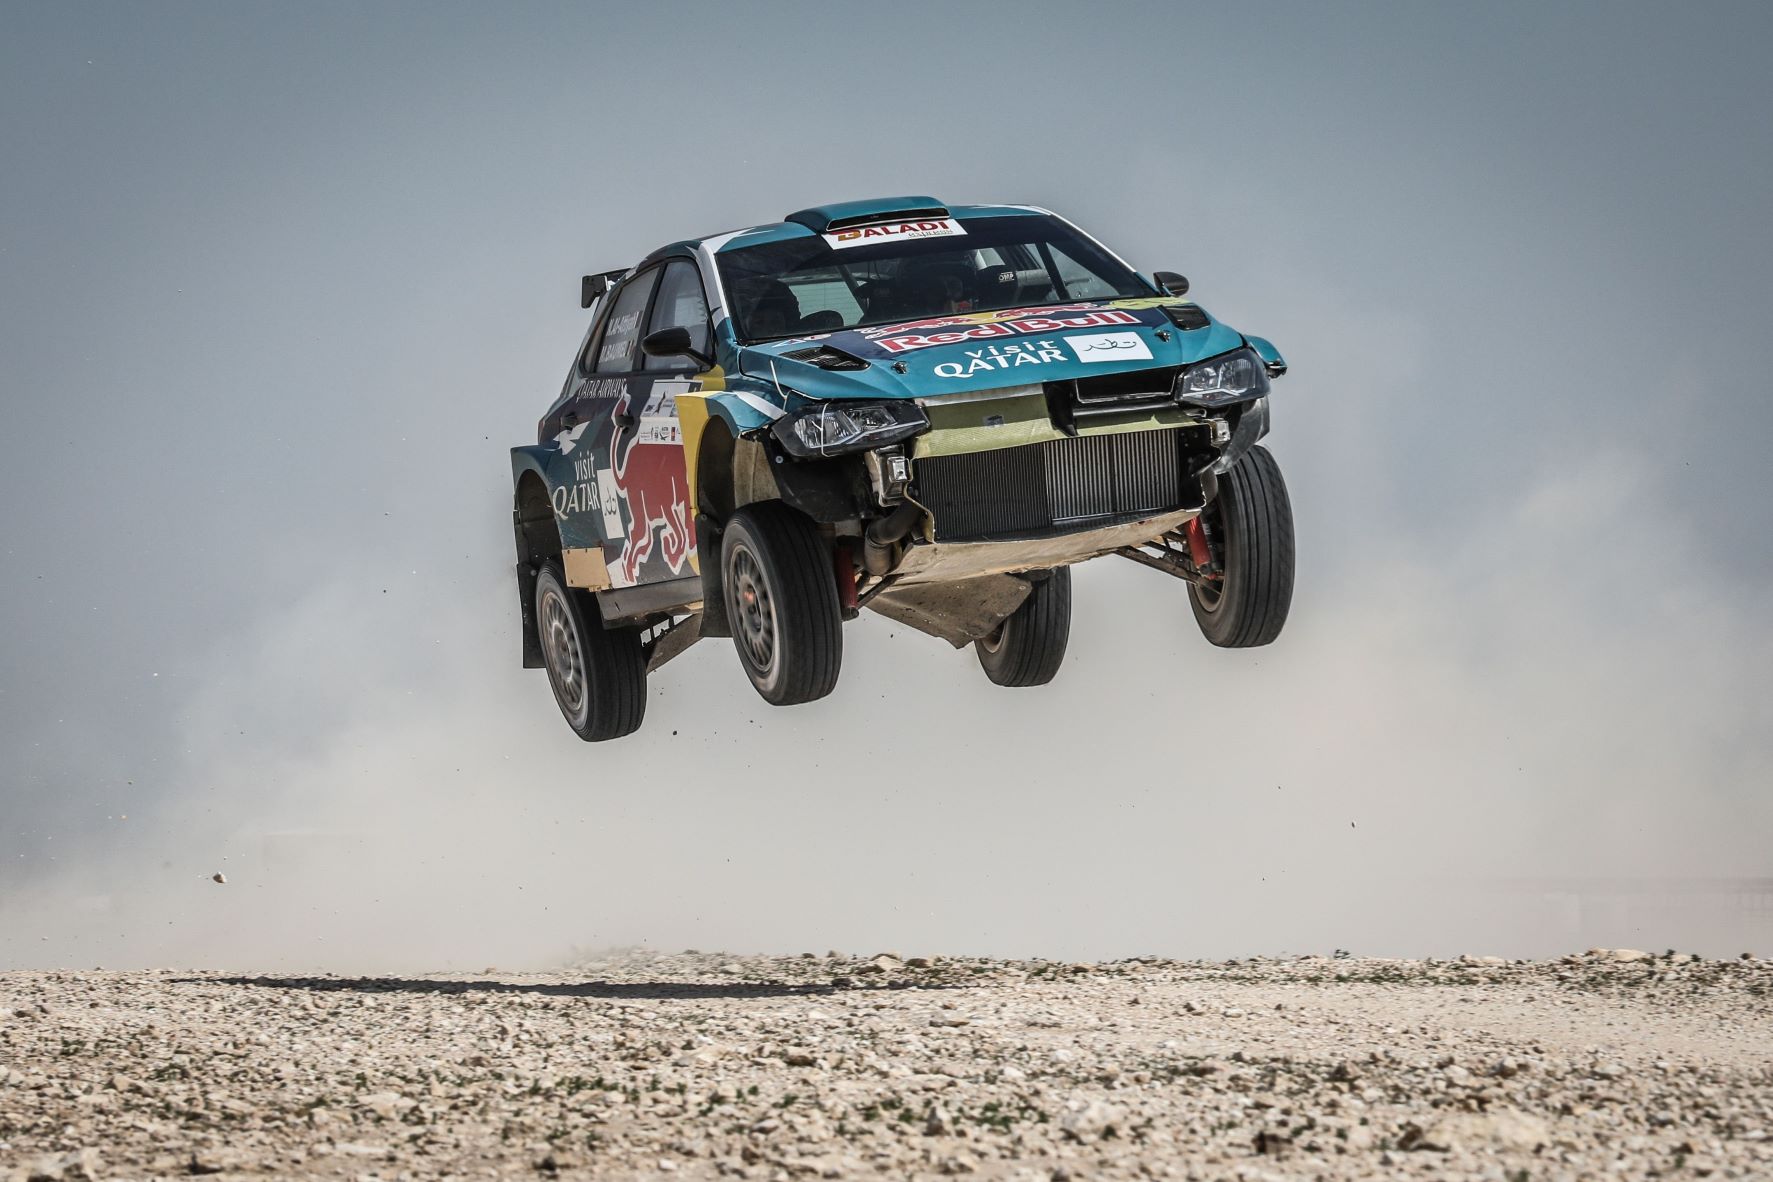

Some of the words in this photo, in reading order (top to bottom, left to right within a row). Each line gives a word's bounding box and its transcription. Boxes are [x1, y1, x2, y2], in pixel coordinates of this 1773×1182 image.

[831, 221, 949, 242] BALADI
[999, 272, 1014, 282] OMP
[873, 323, 1015, 352] Red
[1004, 311, 1142, 333] Bull
[964, 340, 1058, 359] visit
[934, 350, 1068, 378] QATAR
[576, 379, 600, 404] QATAR
[574, 450, 596, 482] visit
[552, 481, 600, 520] QATAR
